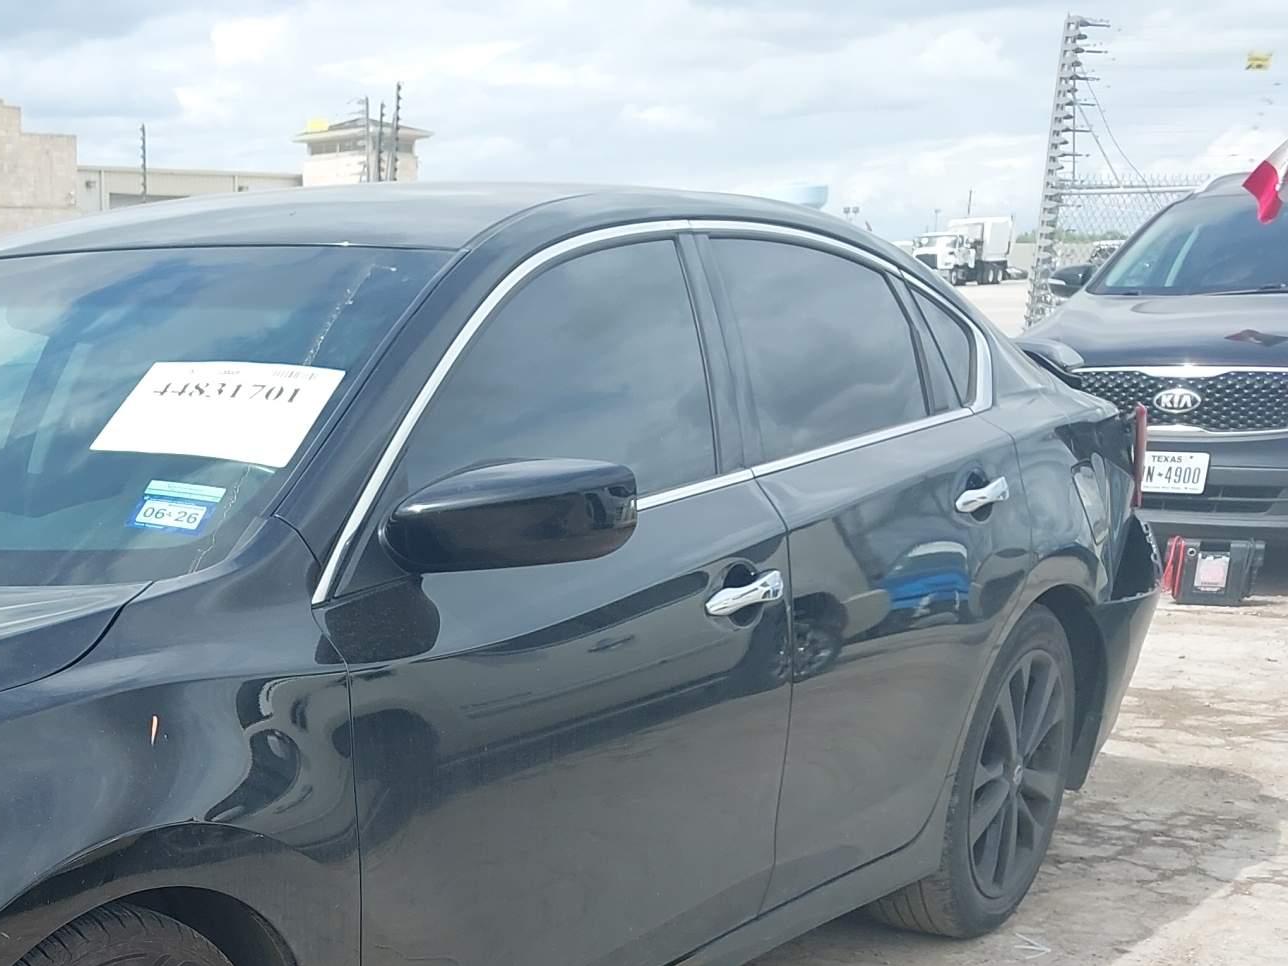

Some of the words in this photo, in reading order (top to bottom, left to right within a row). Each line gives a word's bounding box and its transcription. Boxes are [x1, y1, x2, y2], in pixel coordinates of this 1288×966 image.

[153, 382, 301, 403] 44831701
[1160, 392, 1193, 408] KIA
[1151, 455, 1183, 464] TEXAS
